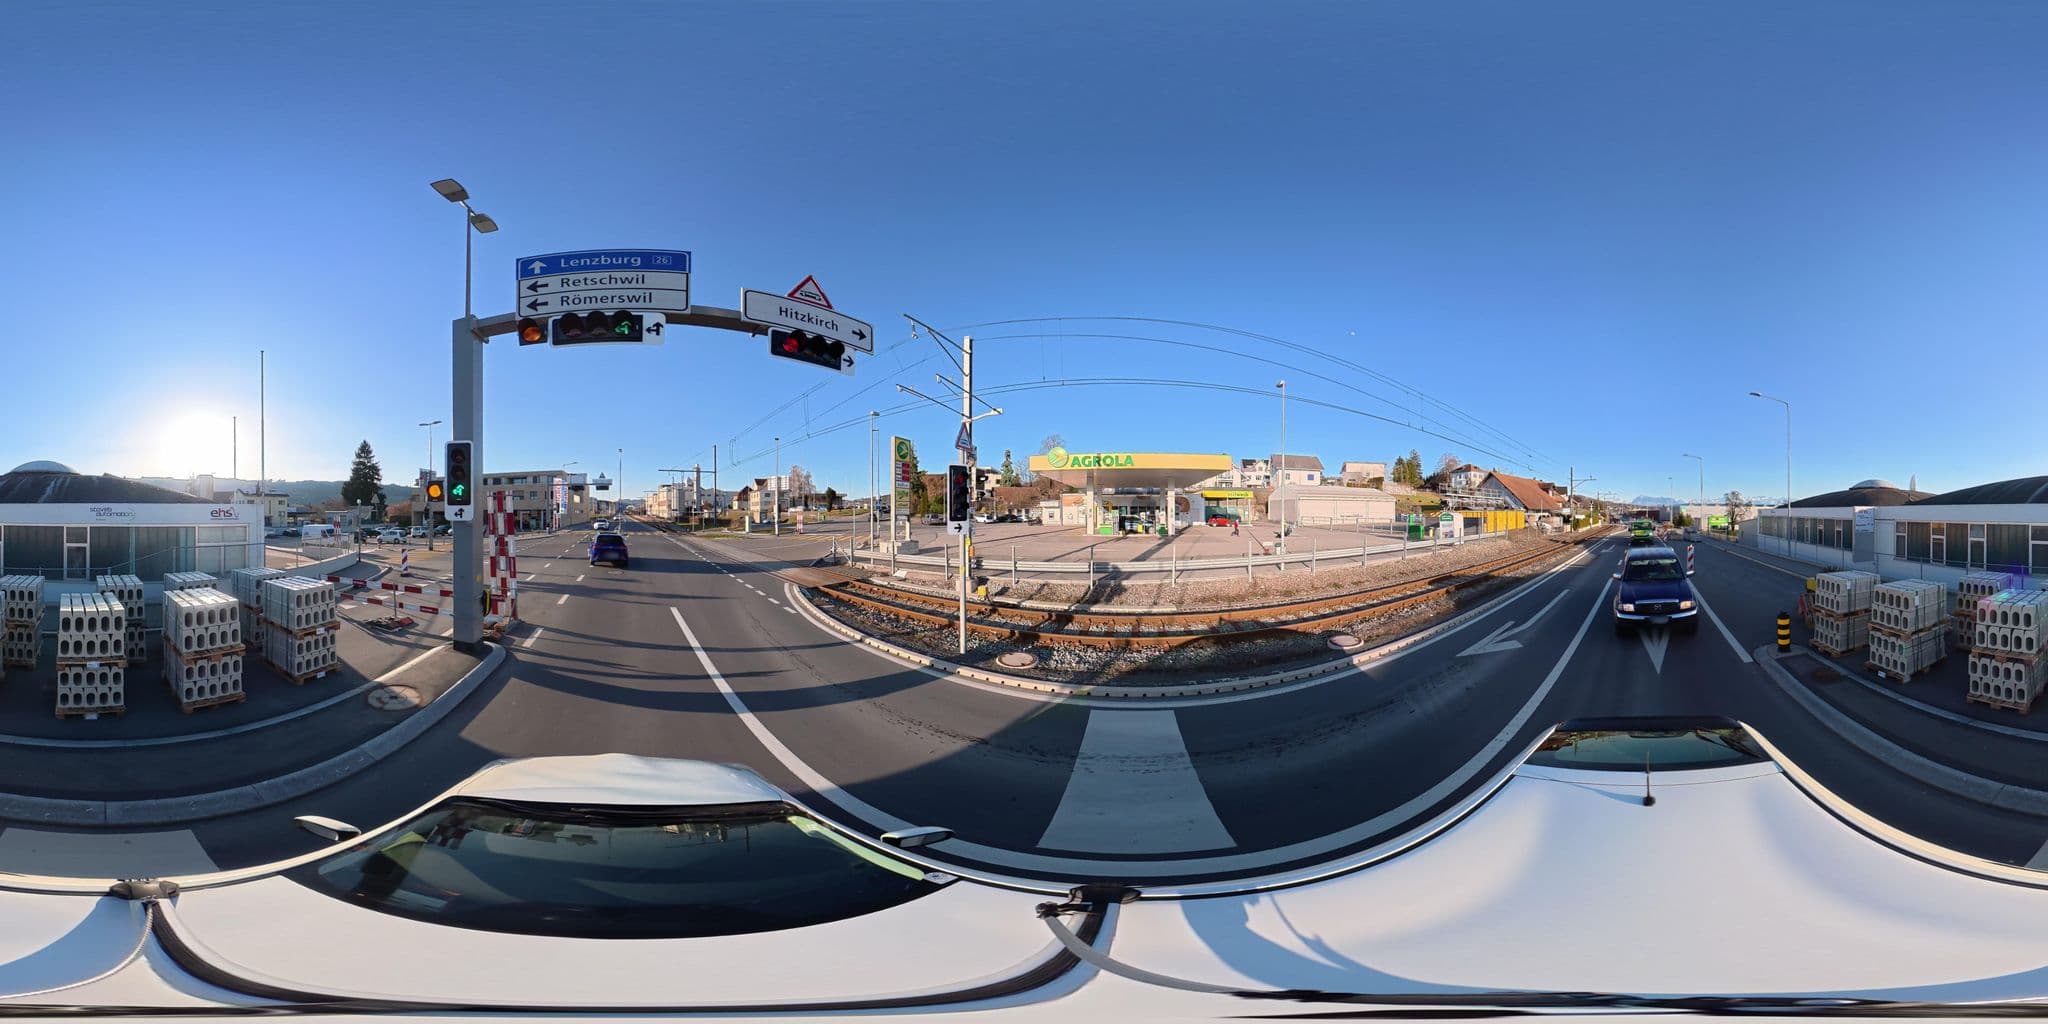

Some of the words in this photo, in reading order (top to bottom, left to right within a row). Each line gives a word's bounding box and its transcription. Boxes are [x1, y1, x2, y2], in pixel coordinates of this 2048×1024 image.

[560, 255, 642, 267] Lenzburg
[655, 256, 669, 264] 26
[560, 274, 645, 288] Retschwil
[560, 292, 653, 306] Römerswil
[779, 306, 839, 332] Hitzkirch
[1070, 455, 1134, 468] AGROLA
[210, 508, 233, 518] ehs
